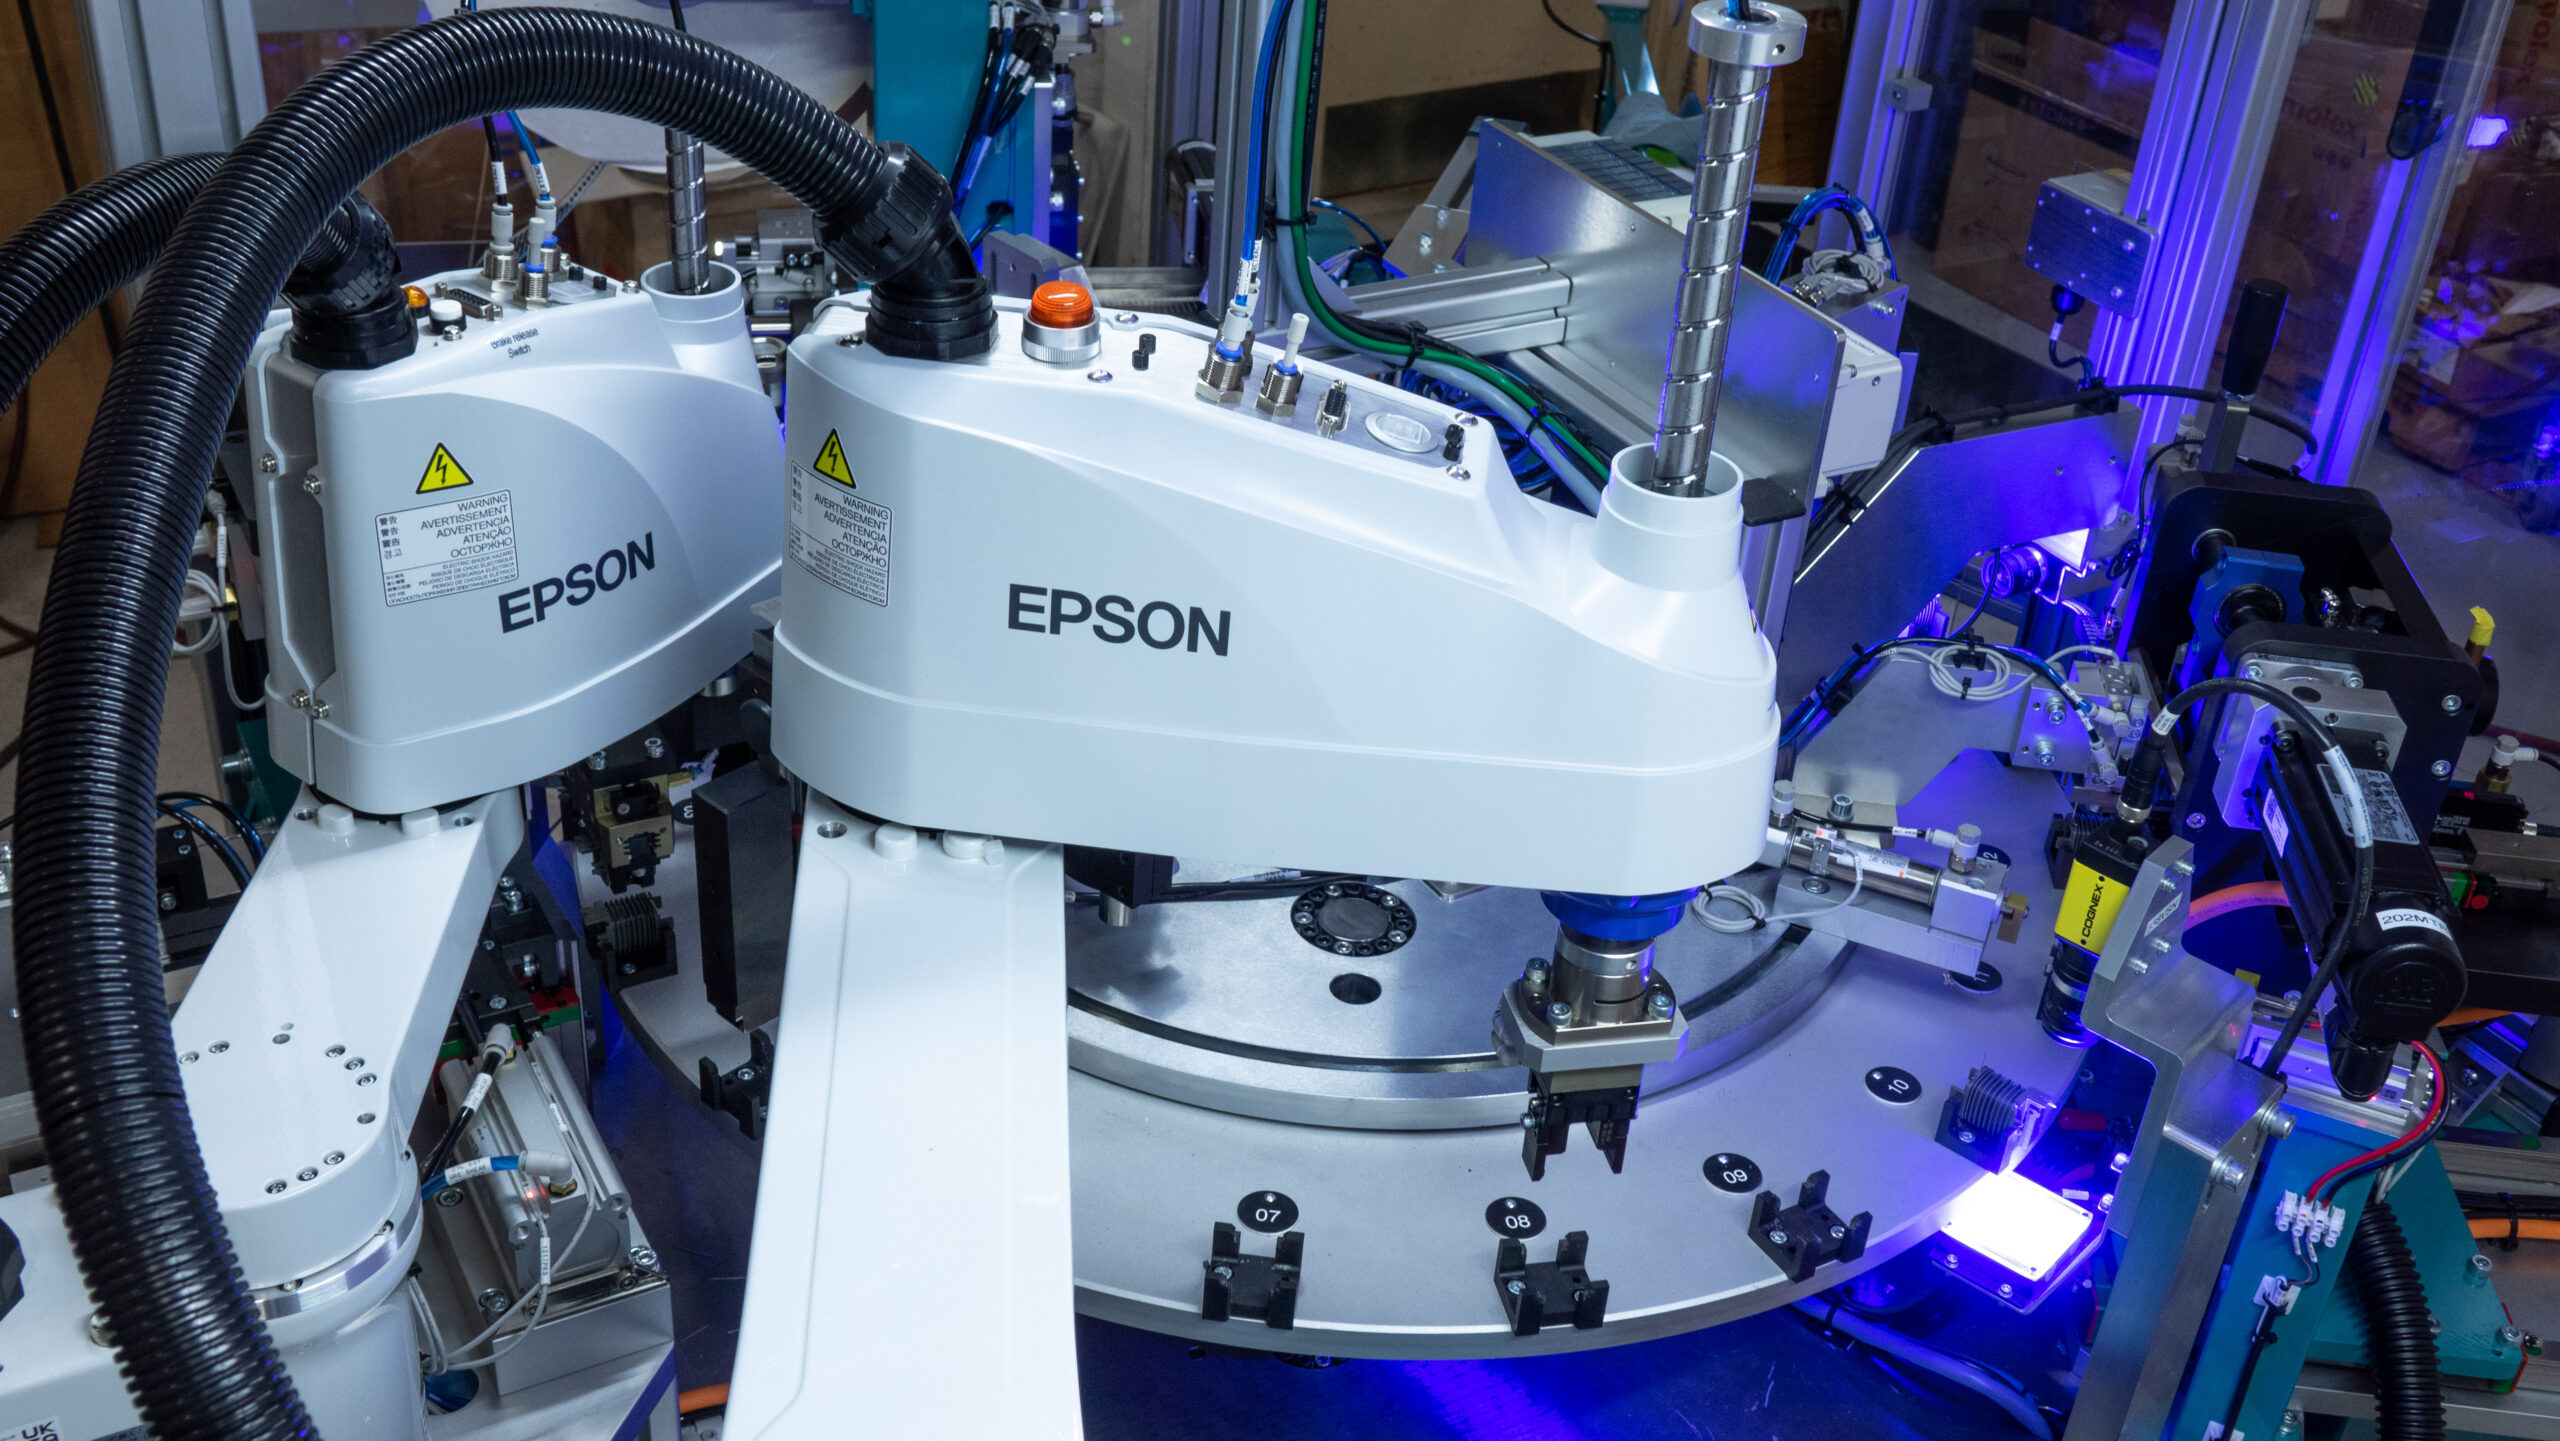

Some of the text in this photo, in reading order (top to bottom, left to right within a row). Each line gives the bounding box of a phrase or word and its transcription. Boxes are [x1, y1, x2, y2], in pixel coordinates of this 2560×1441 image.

[508, 343, 531, 358] Switch
[457, 493, 508, 512] WARNING
[814, 492, 888, 532] AVERTISSEMENT
[842, 495, 889, 520] WARNING
[420, 504, 508, 530] AVERTISSEMENT
[436, 515, 510, 538] ADVERTENCIA
[823, 510, 888, 544] ADVERTENCIA
[462, 526, 512, 545] ATENÇÃO
[842, 531, 887, 557] ATENÇÃO
[491, 550, 514, 560] HAZARD
[498, 531, 655, 633] EPSON
[1008, 583, 1231, 656] EPSON
[2082, 883, 2104, 938] COGNEX
[1888, 1079, 1909, 1094] 10
[1723, 1169, 1748, 1184] 09
[1255, 1208, 1281, 1223] 07
[1505, 1215, 1531, 1229] 08
[22, 1420, 55, 1439] UK
